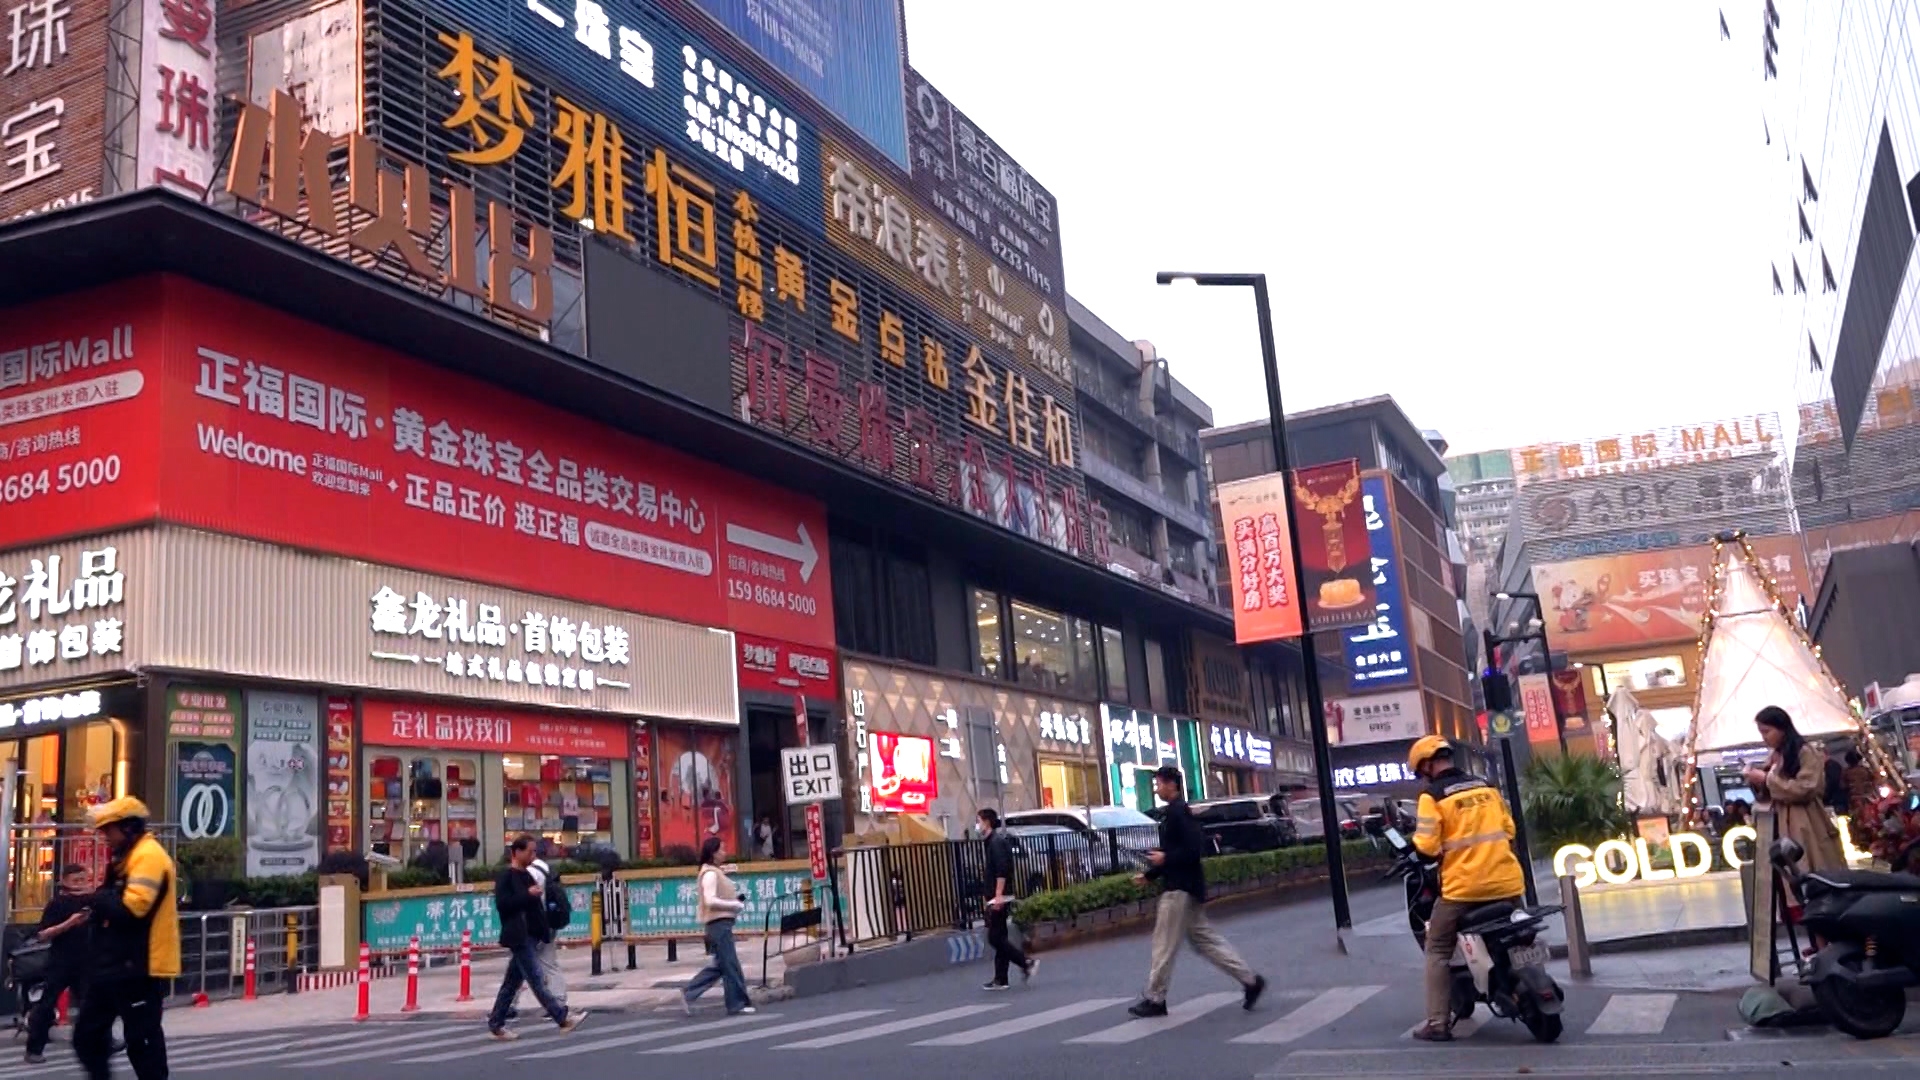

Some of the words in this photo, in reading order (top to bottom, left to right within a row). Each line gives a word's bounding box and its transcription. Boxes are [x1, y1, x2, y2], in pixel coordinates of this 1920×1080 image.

[437, 32, 721, 288] 梦雅恒
[963, 344, 1074, 468] 金佳和
[196, 423, 307, 476] Welcome
[1681, 417, 1774, 452] MALL
[56, 454, 122, 493] 5000
[404, 474, 507, 528] 正品正价
[514, 501, 581, 547] 逛正福
[727, 578, 752, 600] 159
[754, 584, 786, 608] 8684
[788, 592, 817, 616] 5000
[371, 585, 630, 665] 鑫龙礼品·首饰包装
[392, 711, 512, 745] 定礼品找我们
[789, 753, 832, 777] 出口
[792, 776, 833, 797] EXIT
[1553, 831, 1713, 889] GOLD
